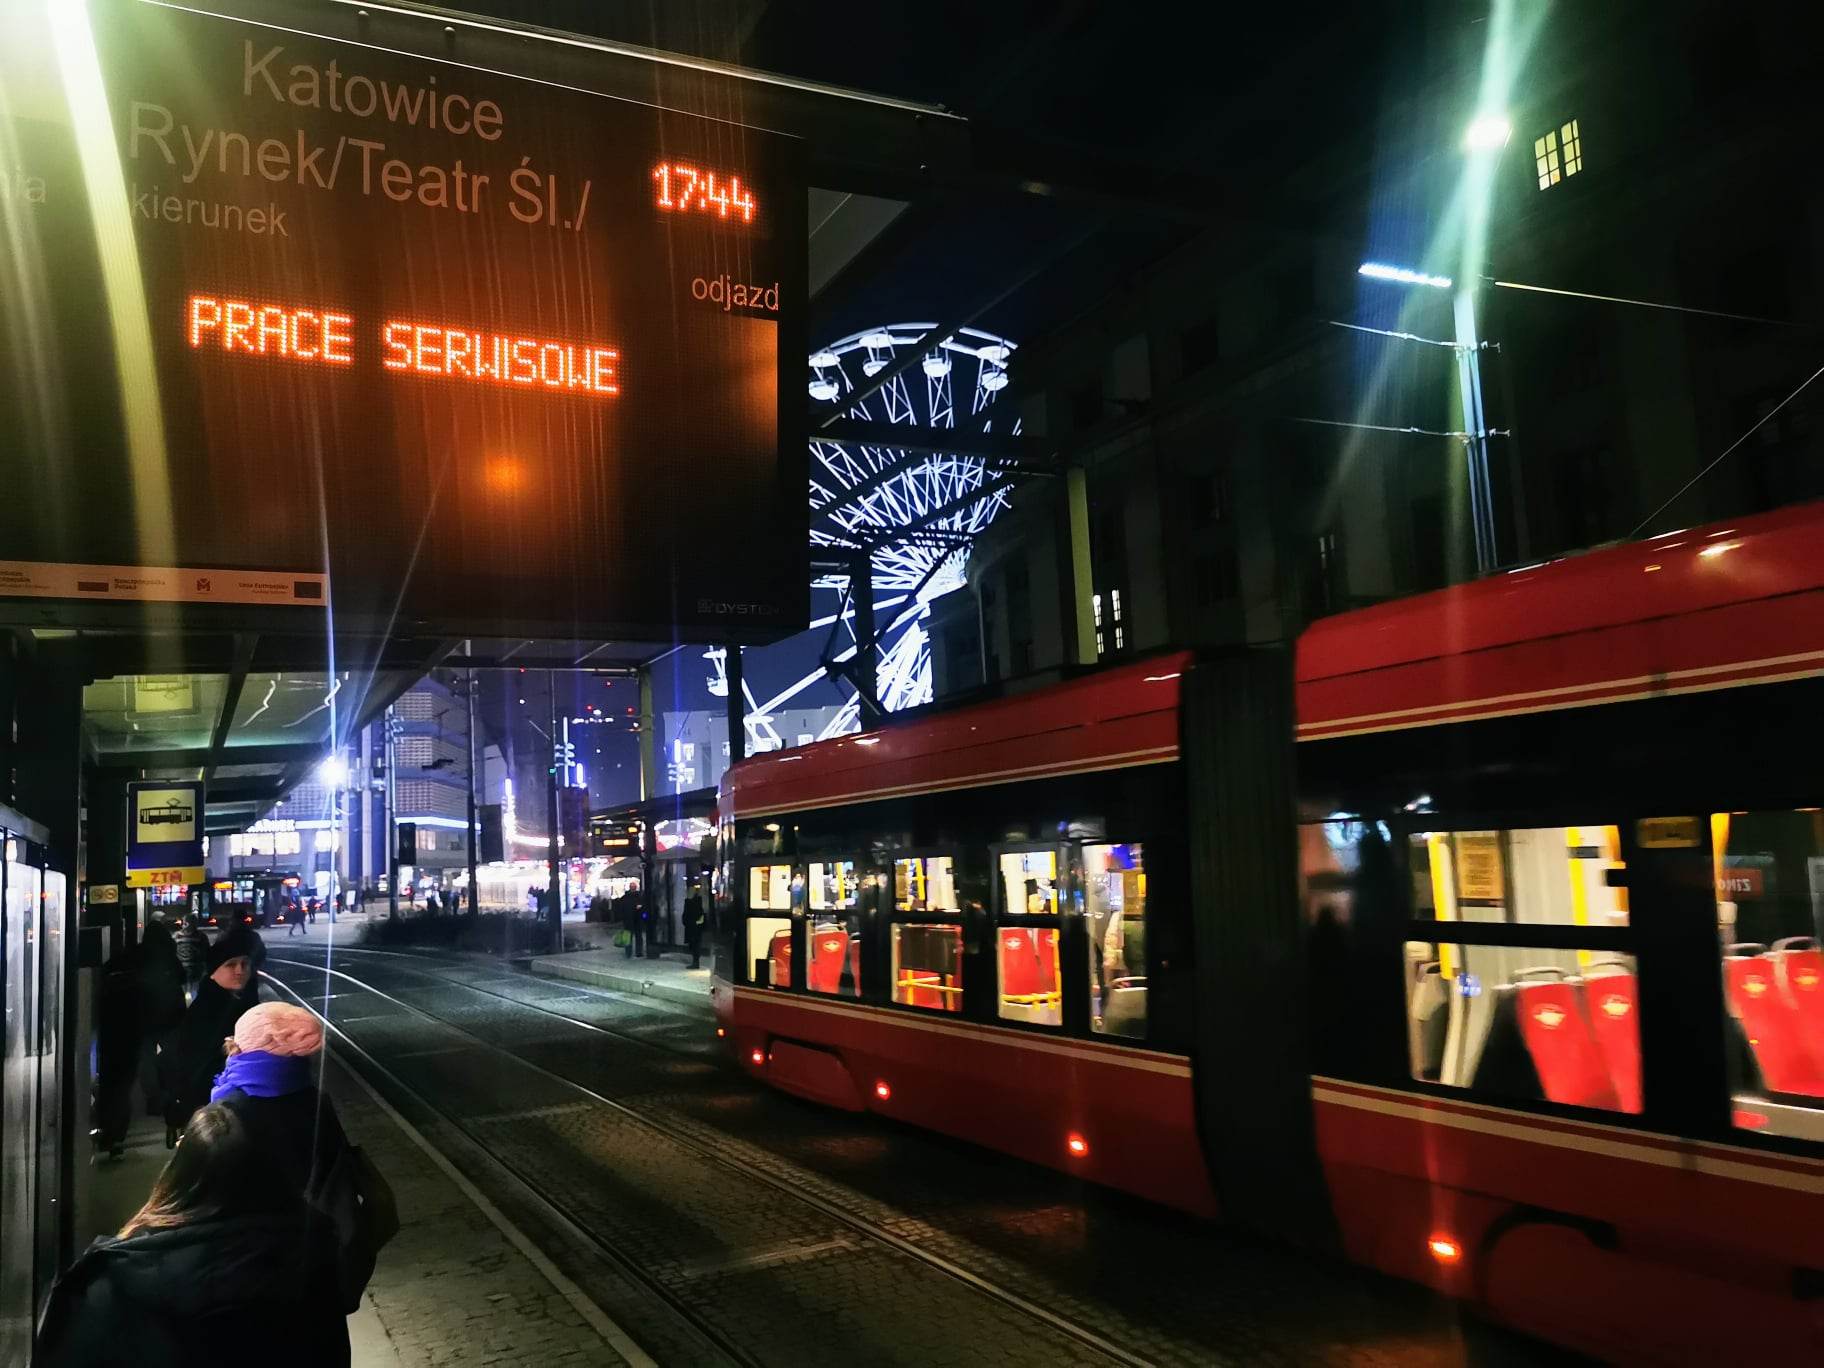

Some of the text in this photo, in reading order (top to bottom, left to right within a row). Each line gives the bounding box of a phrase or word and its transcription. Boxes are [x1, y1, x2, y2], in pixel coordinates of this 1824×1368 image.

[243, 39, 503, 140] Katowice
[129, 101, 591, 231] Rynek/Teatr Śl./
[654, 163, 754, 221] 17:44
[130, 182, 289, 236] kierunek
[692, 274, 779, 311] odjazd
[189, 297, 620, 394] PRACE SERWISOWE
[150, 870, 182, 884] ZTM
